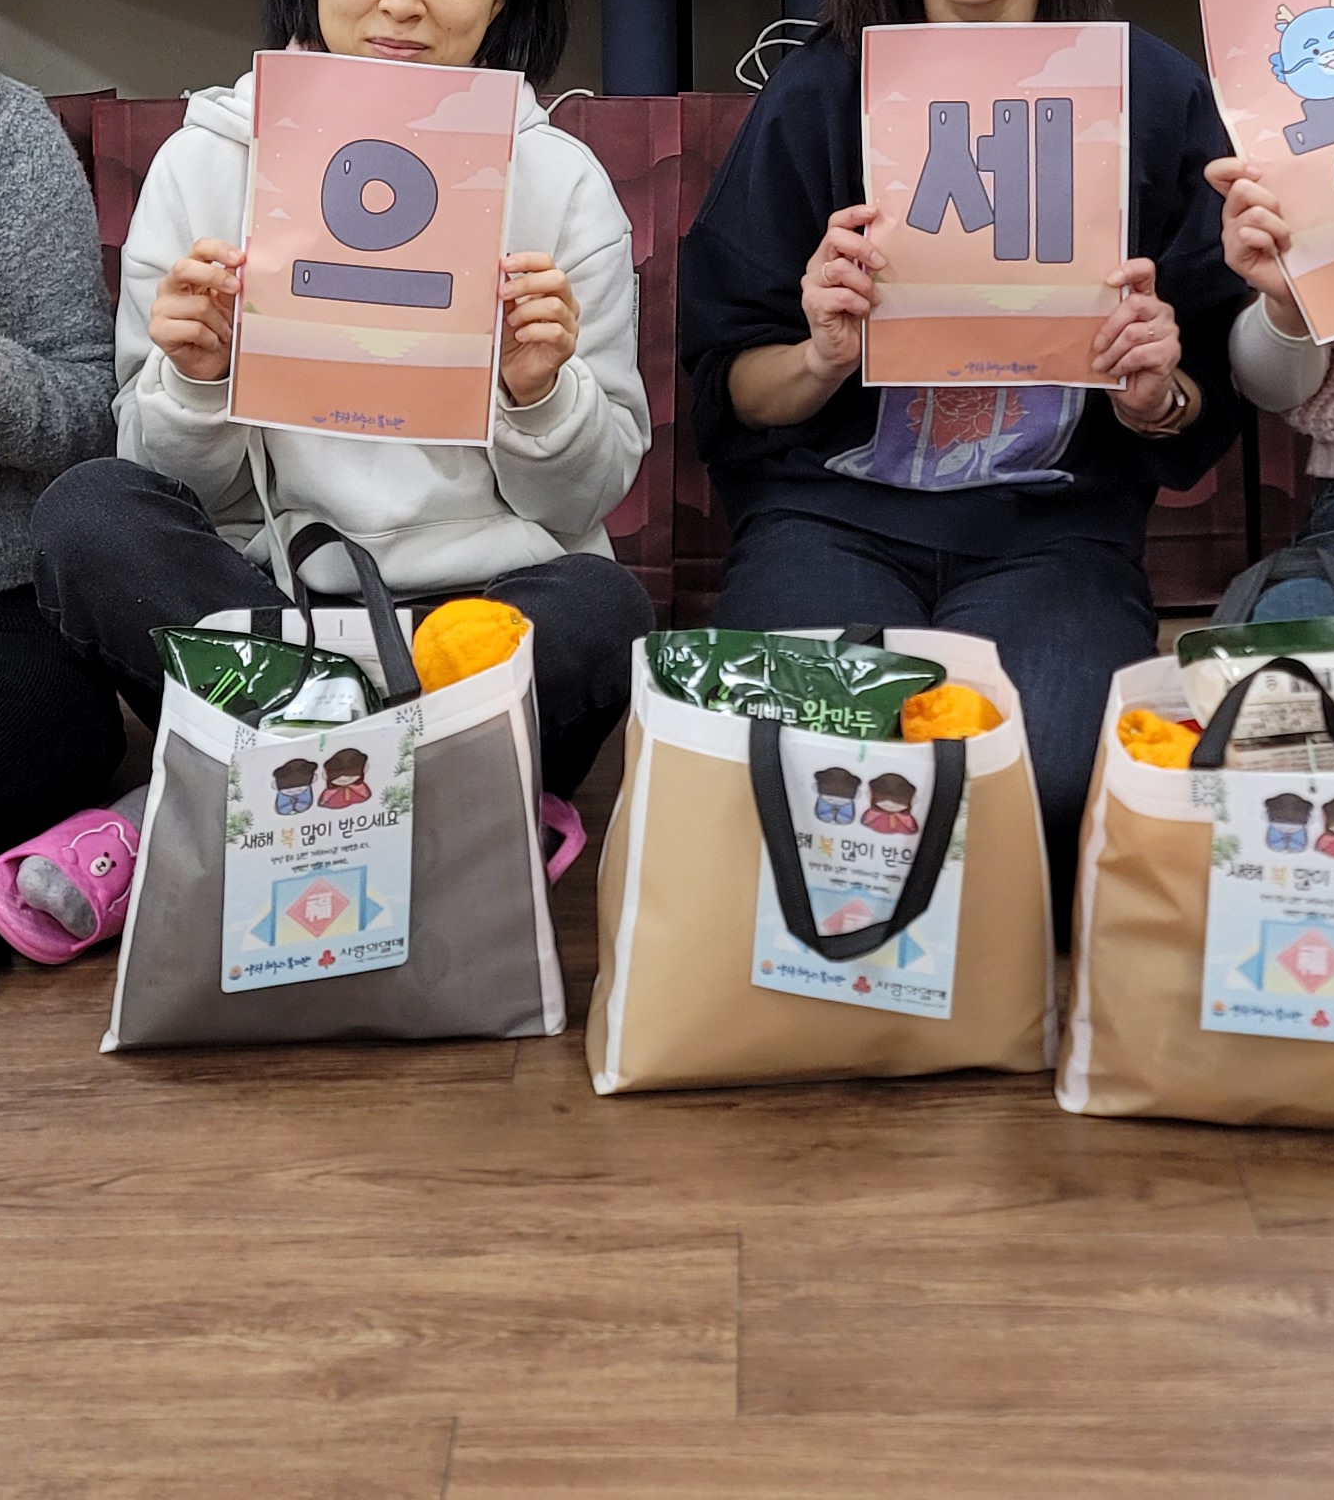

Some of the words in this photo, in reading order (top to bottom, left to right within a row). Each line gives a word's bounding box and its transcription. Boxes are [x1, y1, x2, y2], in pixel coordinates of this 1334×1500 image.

[906, 97, 1074, 264] 세
[291, 138, 454, 310] 으
[746, 702, 799, 726] 비비고
[800, 699, 878, 738] 왕만두
[240, 831, 274, 850] 새해
[280, 827, 296, 849] 복
[301, 821, 332, 847] 많이
[338, 811, 400, 839] 받으세요
[797, 832, 813, 849] 해
[841, 839, 874, 862] 많이
[882, 845, 914, 868] 받으
